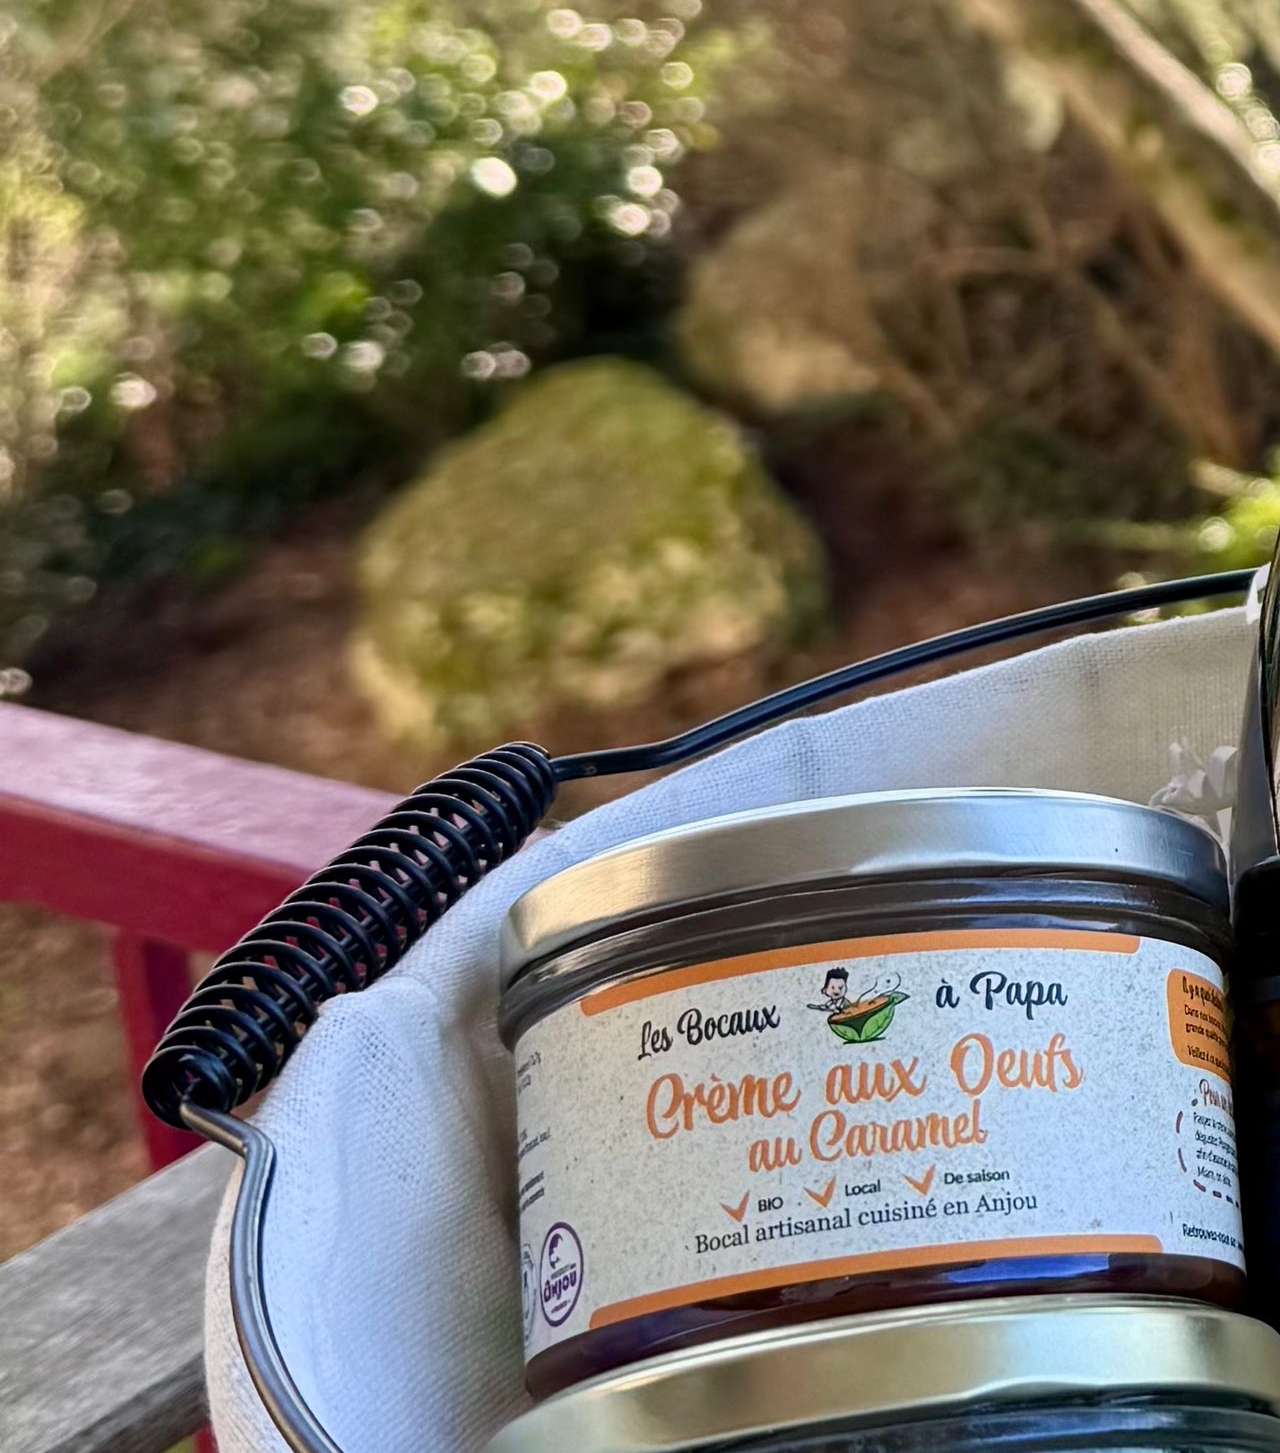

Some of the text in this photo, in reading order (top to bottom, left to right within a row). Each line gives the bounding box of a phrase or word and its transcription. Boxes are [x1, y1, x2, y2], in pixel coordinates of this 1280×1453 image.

[638, 971, 1069, 1061] Les Bocaux à Papa
[646, 1032, 1085, 1140] Crème aux Oeufs
[748, 1098, 989, 1173] au Caramel
[695, 1194, 1039, 1255] Bocal artisanal cuisiné en Anjou
[758, 1167, 1011, 1214] BIO Local De saison
